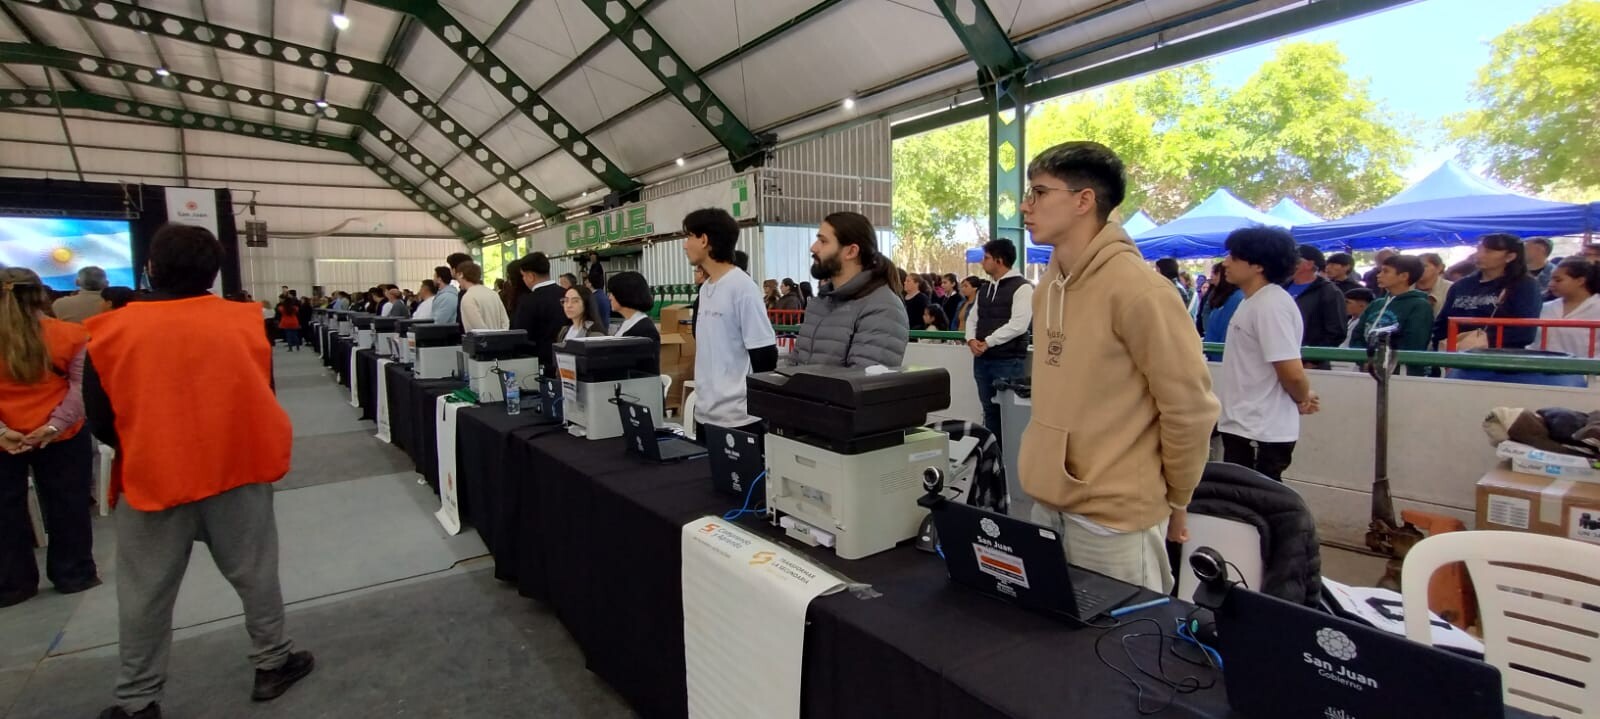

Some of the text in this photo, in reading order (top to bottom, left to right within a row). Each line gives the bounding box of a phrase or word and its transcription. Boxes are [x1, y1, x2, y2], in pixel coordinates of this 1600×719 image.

[565, 204, 654, 249] C.D.U.E.
[977, 535, 1013, 553] San Juan
[1303, 652, 1378, 689] San Juan
[1318, 668, 1363, 691] Gobierno
